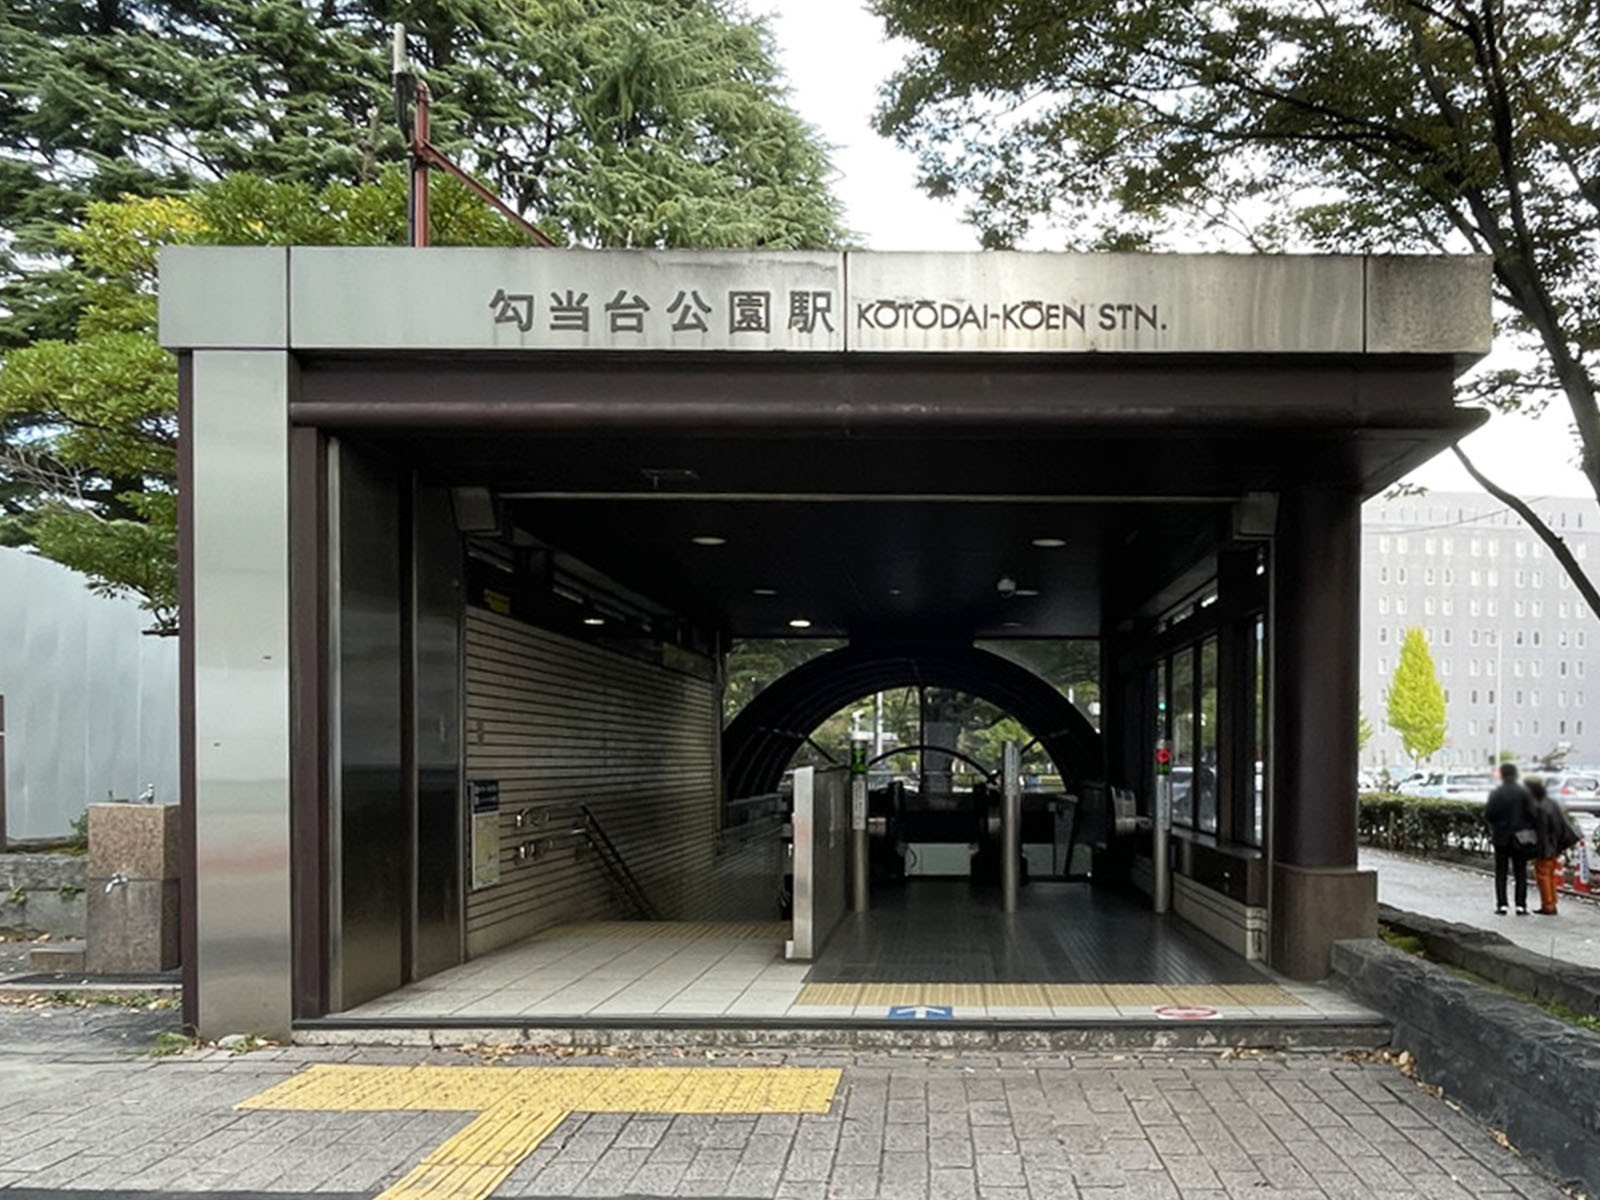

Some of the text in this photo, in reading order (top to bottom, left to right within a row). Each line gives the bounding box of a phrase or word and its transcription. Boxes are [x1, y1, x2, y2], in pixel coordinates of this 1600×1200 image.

[489, 289, 834, 334] 勾当台公園駅
[1099, 303, 1167, 330] STN.
